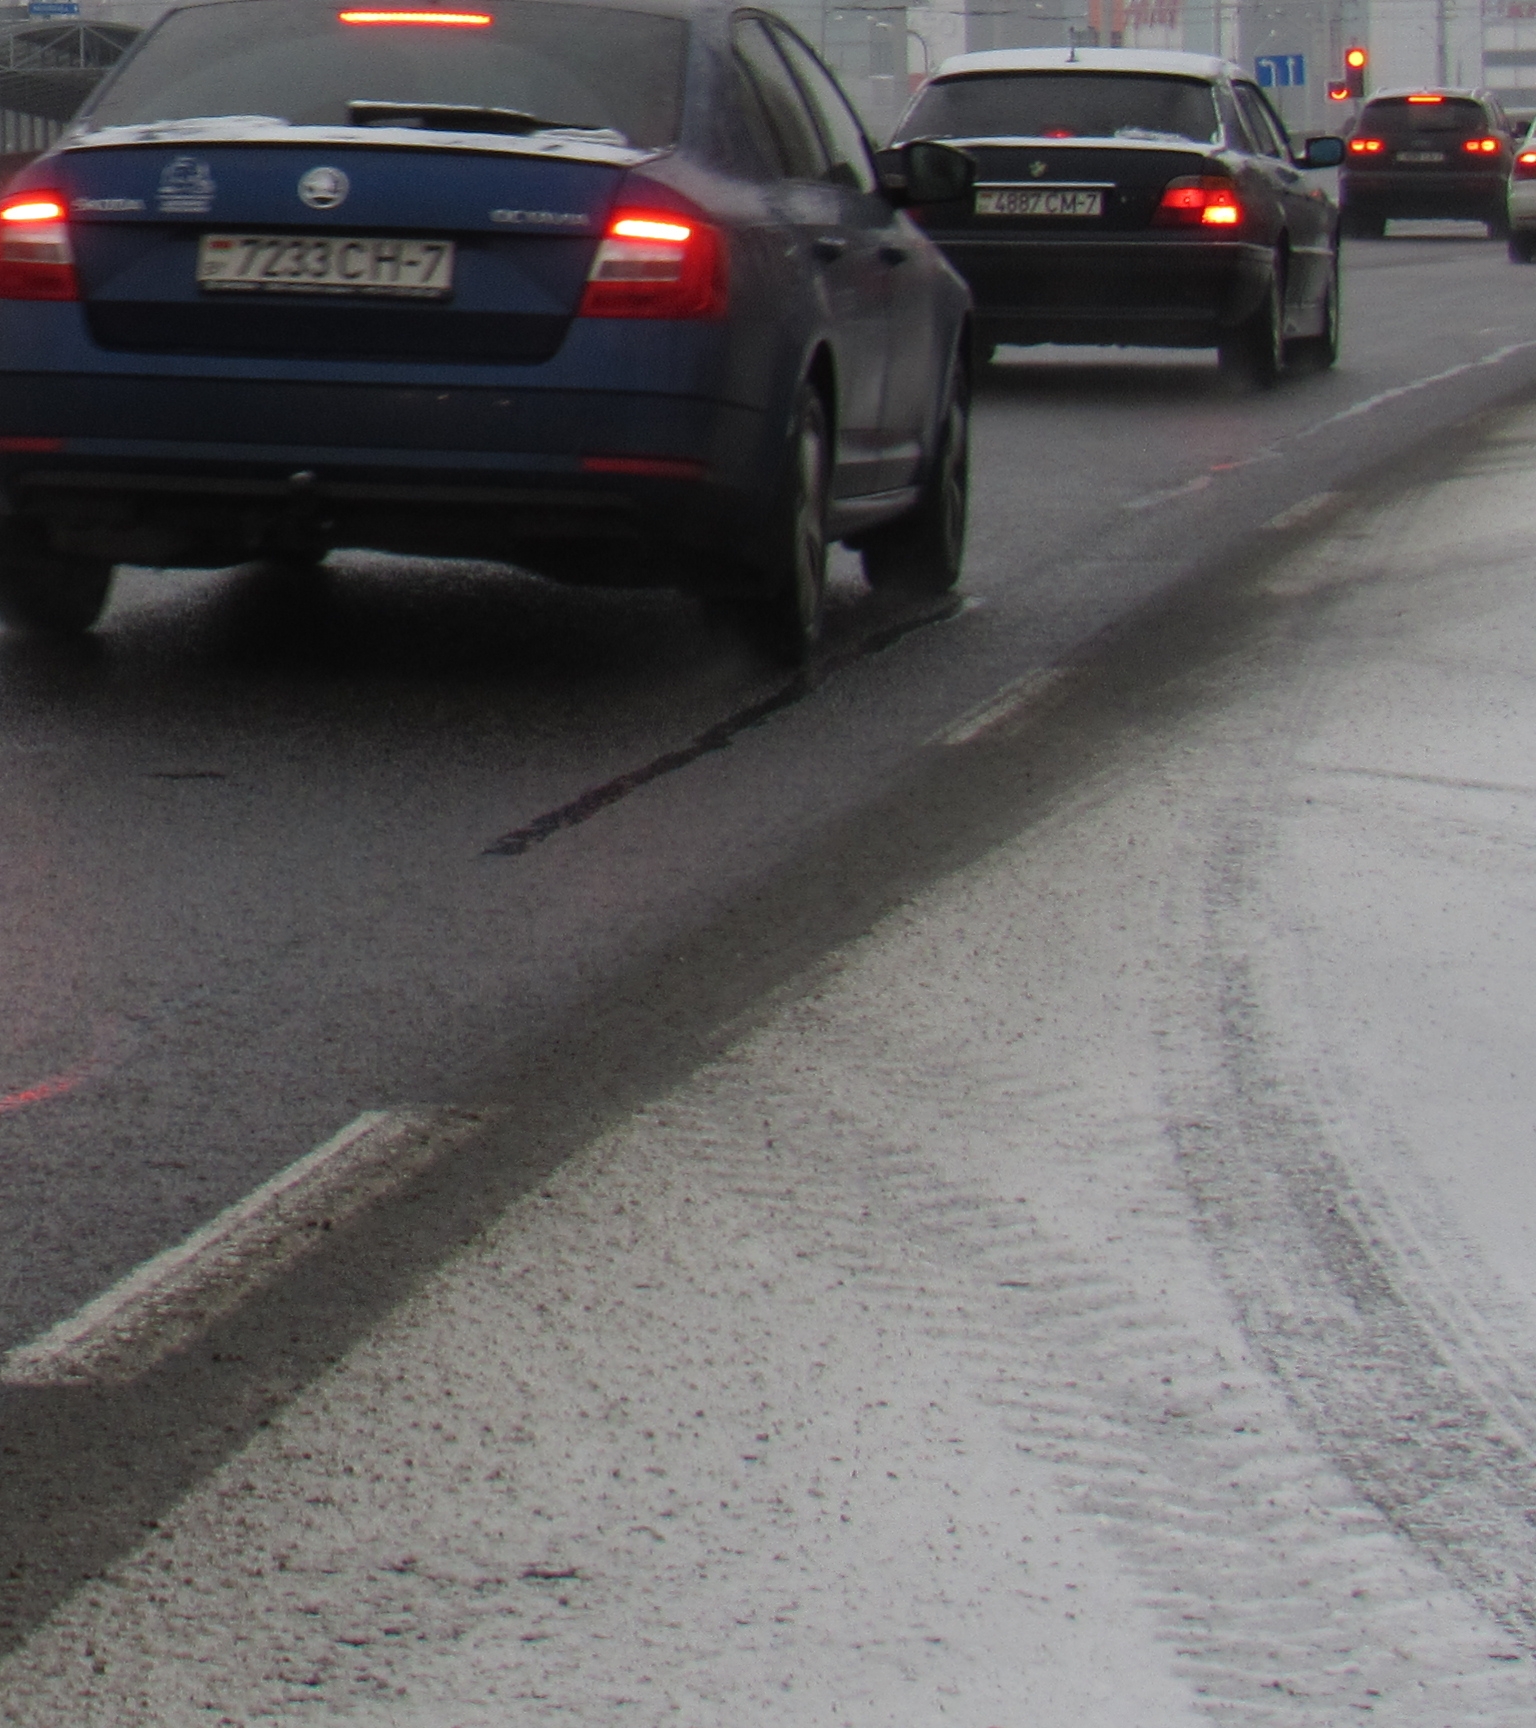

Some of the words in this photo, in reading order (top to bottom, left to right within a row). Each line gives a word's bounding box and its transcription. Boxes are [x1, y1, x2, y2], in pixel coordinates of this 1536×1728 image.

[995, 193, 1041, 214] 4887
[1044, 193, 1097, 215] CM-7
[238, 238, 328, 278] 7233
[338, 240, 448, 282] CH-7
